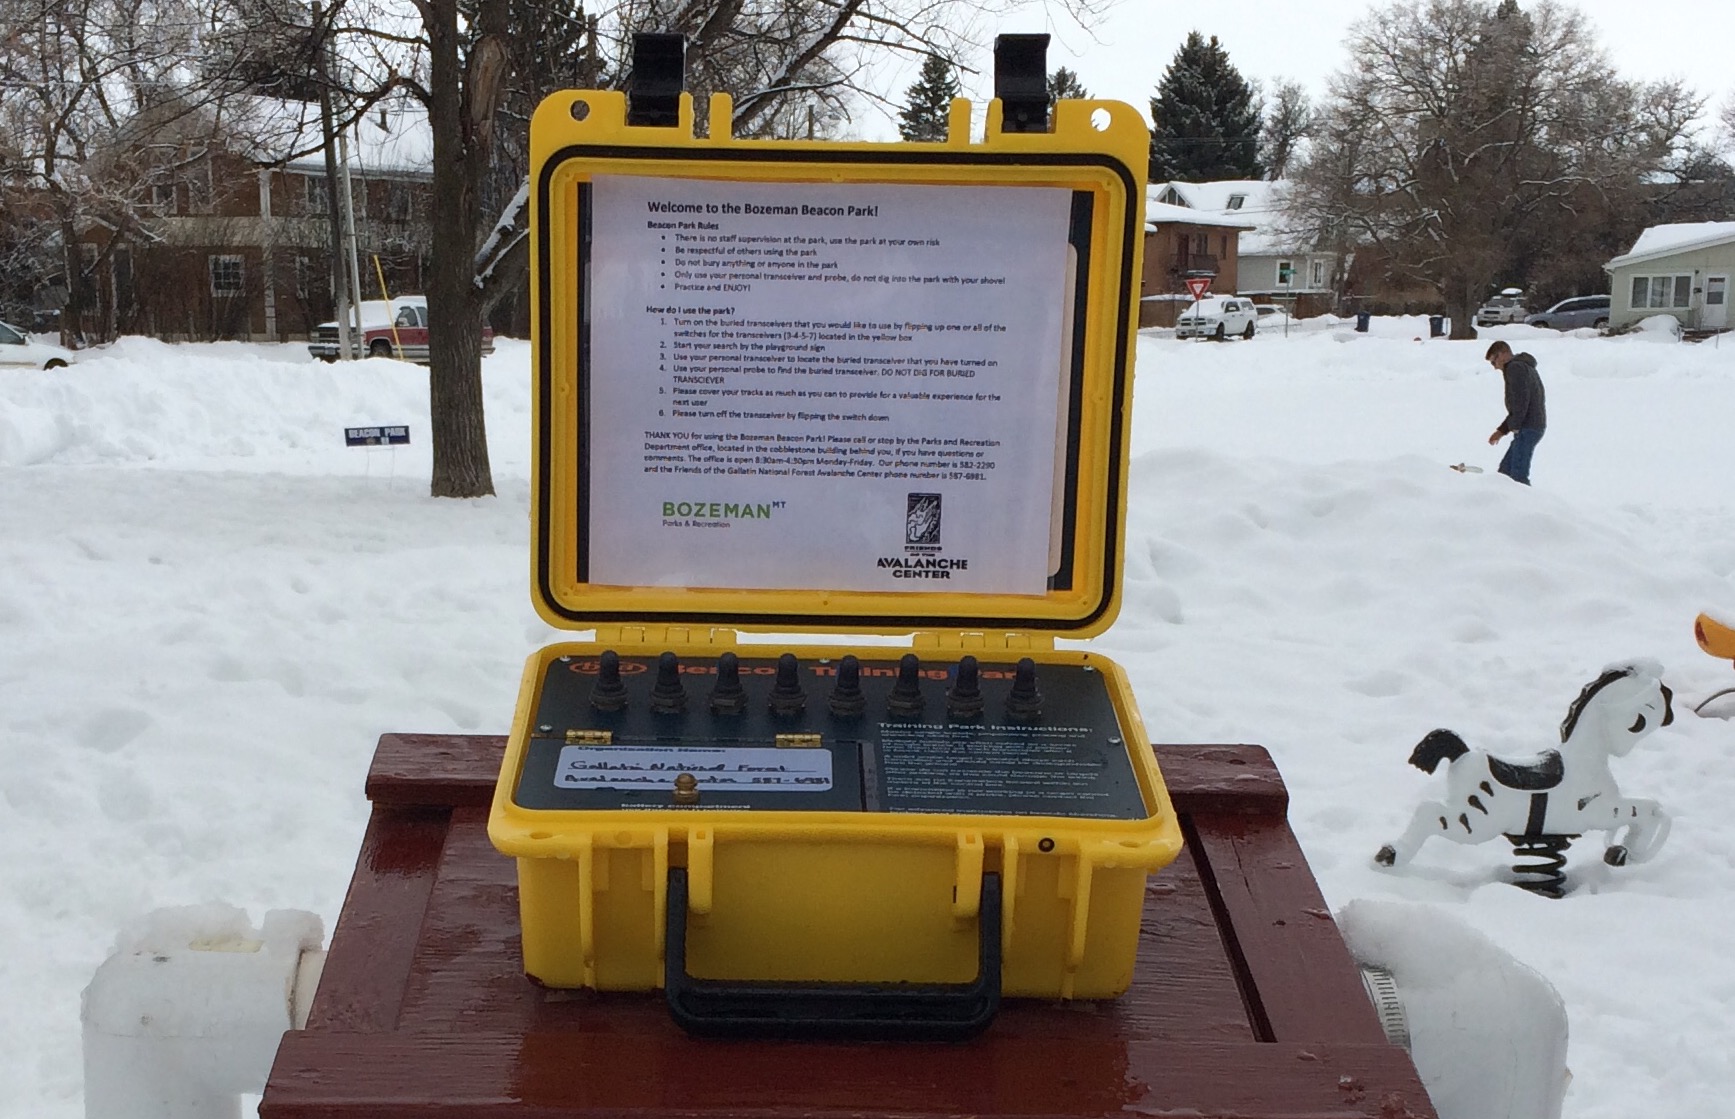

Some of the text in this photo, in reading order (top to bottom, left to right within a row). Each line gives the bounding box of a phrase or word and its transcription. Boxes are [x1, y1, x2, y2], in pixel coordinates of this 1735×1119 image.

[647, 202, 878, 217] Welcome to the Bozeman Beacon Park!
[647, 221, 719, 230] Beacon Park Rules
[646, 306, 664, 314] How
[697, 306, 711, 314] the
[712, 306, 735, 316] park?
[662, 501, 771, 519] BOZEMAN
[662, 519, 683, 527] Parks
[692, 520, 731, 529] Recreation
[877, 558, 968, 570] AVALANCHE
[892, 570, 951, 579] CENTER
[877, 722, 943, 730] Training
[990, 724, 1094, 732] Instructions:
